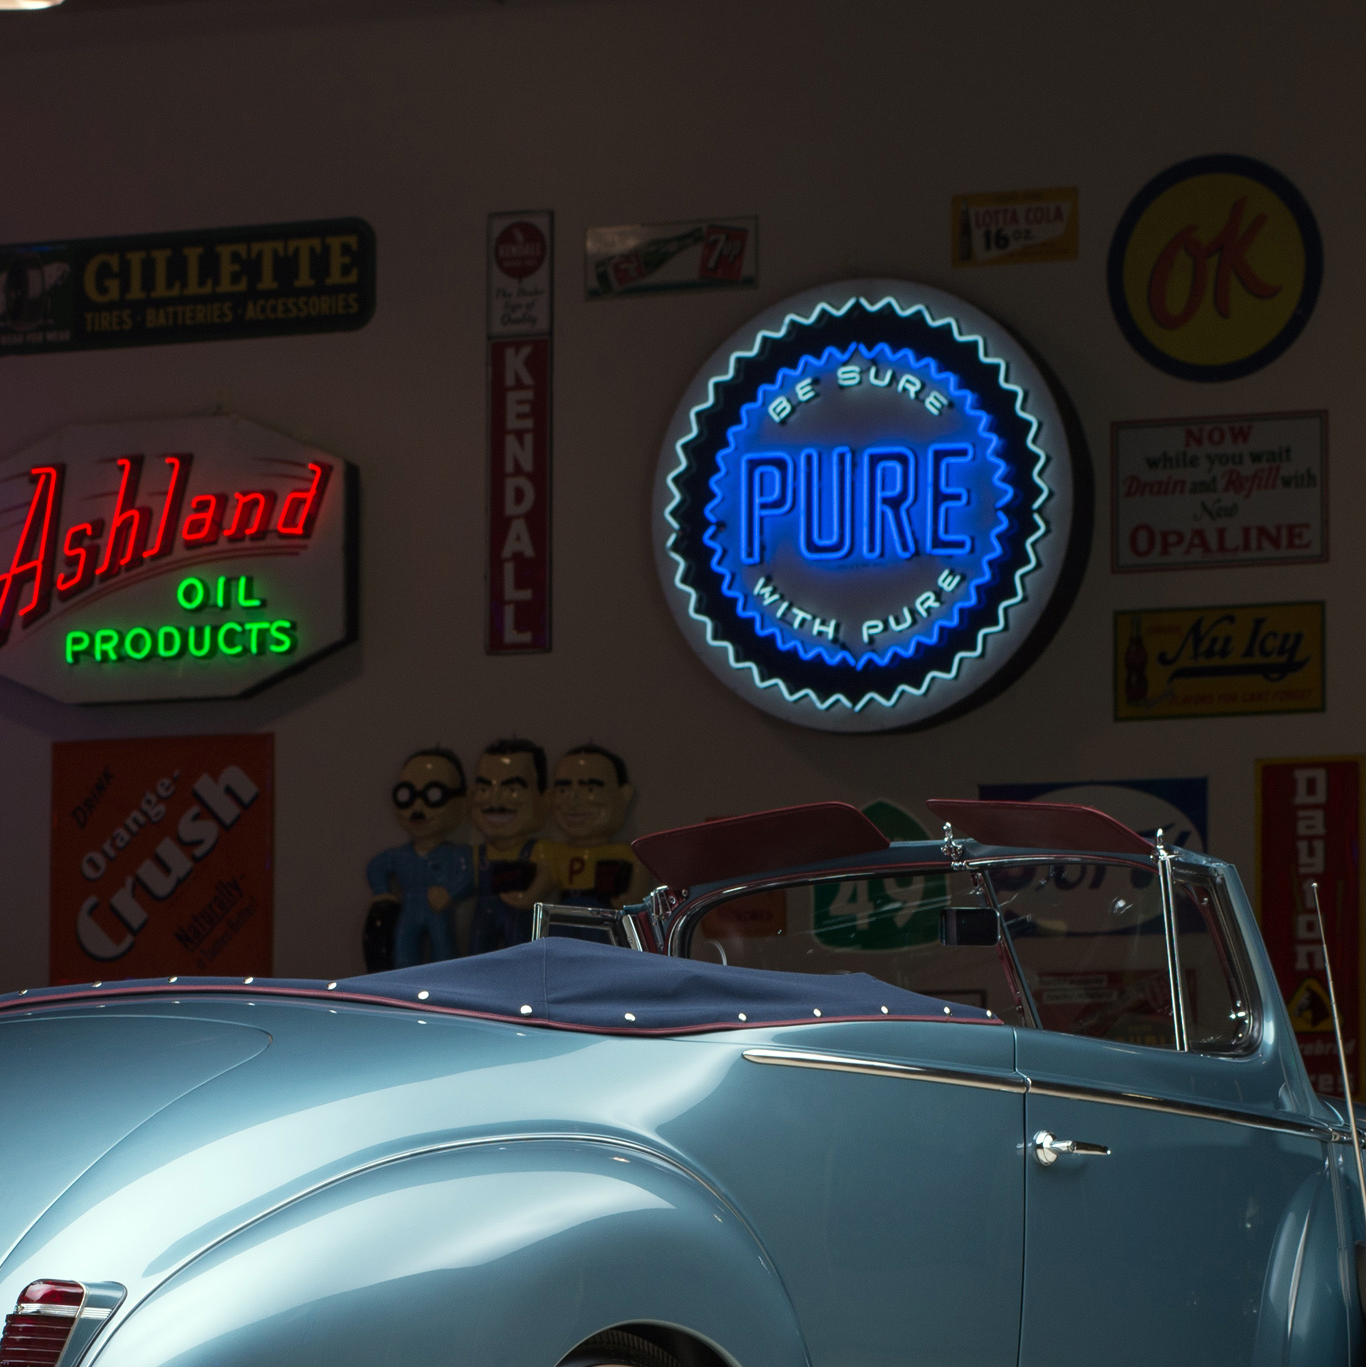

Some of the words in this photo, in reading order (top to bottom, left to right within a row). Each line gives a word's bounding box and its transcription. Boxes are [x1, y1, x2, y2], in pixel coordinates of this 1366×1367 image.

[975, 207, 1019, 229] LOTTA
[1025, 205, 1064, 225] COLA
[984, 228, 1010, 252] 16
[83, 234, 359, 304] GILLETTE
[1148, 196, 1283, 330] OK
[84, 309, 133, 334] TIRES
[146, 302, 234, 329] BATTERIES
[245, 293, 359, 321] ACCESSORIES
[768, 377, 818, 423] BE
[837, 365, 948, 417] SURE
[1146, 451, 1200, 470] while
[1206, 451, 1244, 473] you
[1249, 446, 1292, 465] wait
[1185, 424, 1254, 448] NOW
[501, 344, 536, 647] KENDALL
[740, 441, 974, 566] PURE
[1122, 474, 1187, 499] Drain
[1189, 476, 1218, 495] and
[1222, 466, 1281, 499] Refill
[1282, 467, 1317, 489] with
[1192, 498, 1240, 522] New
[1128, 522, 1313, 558] OPALINE
[176, 575, 263, 609] OIL
[753, 576, 836, 641] WITH
[862, 567, 961, 643] PURE
[64, 619, 295, 664] PRODUCTS
[1157, 614, 1236, 667] Nu
[1240, 617, 1309, 668] Icy
[71, 764, 114, 829] DRINK
[76, 764, 260, 962] Crush
[1292, 766, 1328, 971] Dayton
